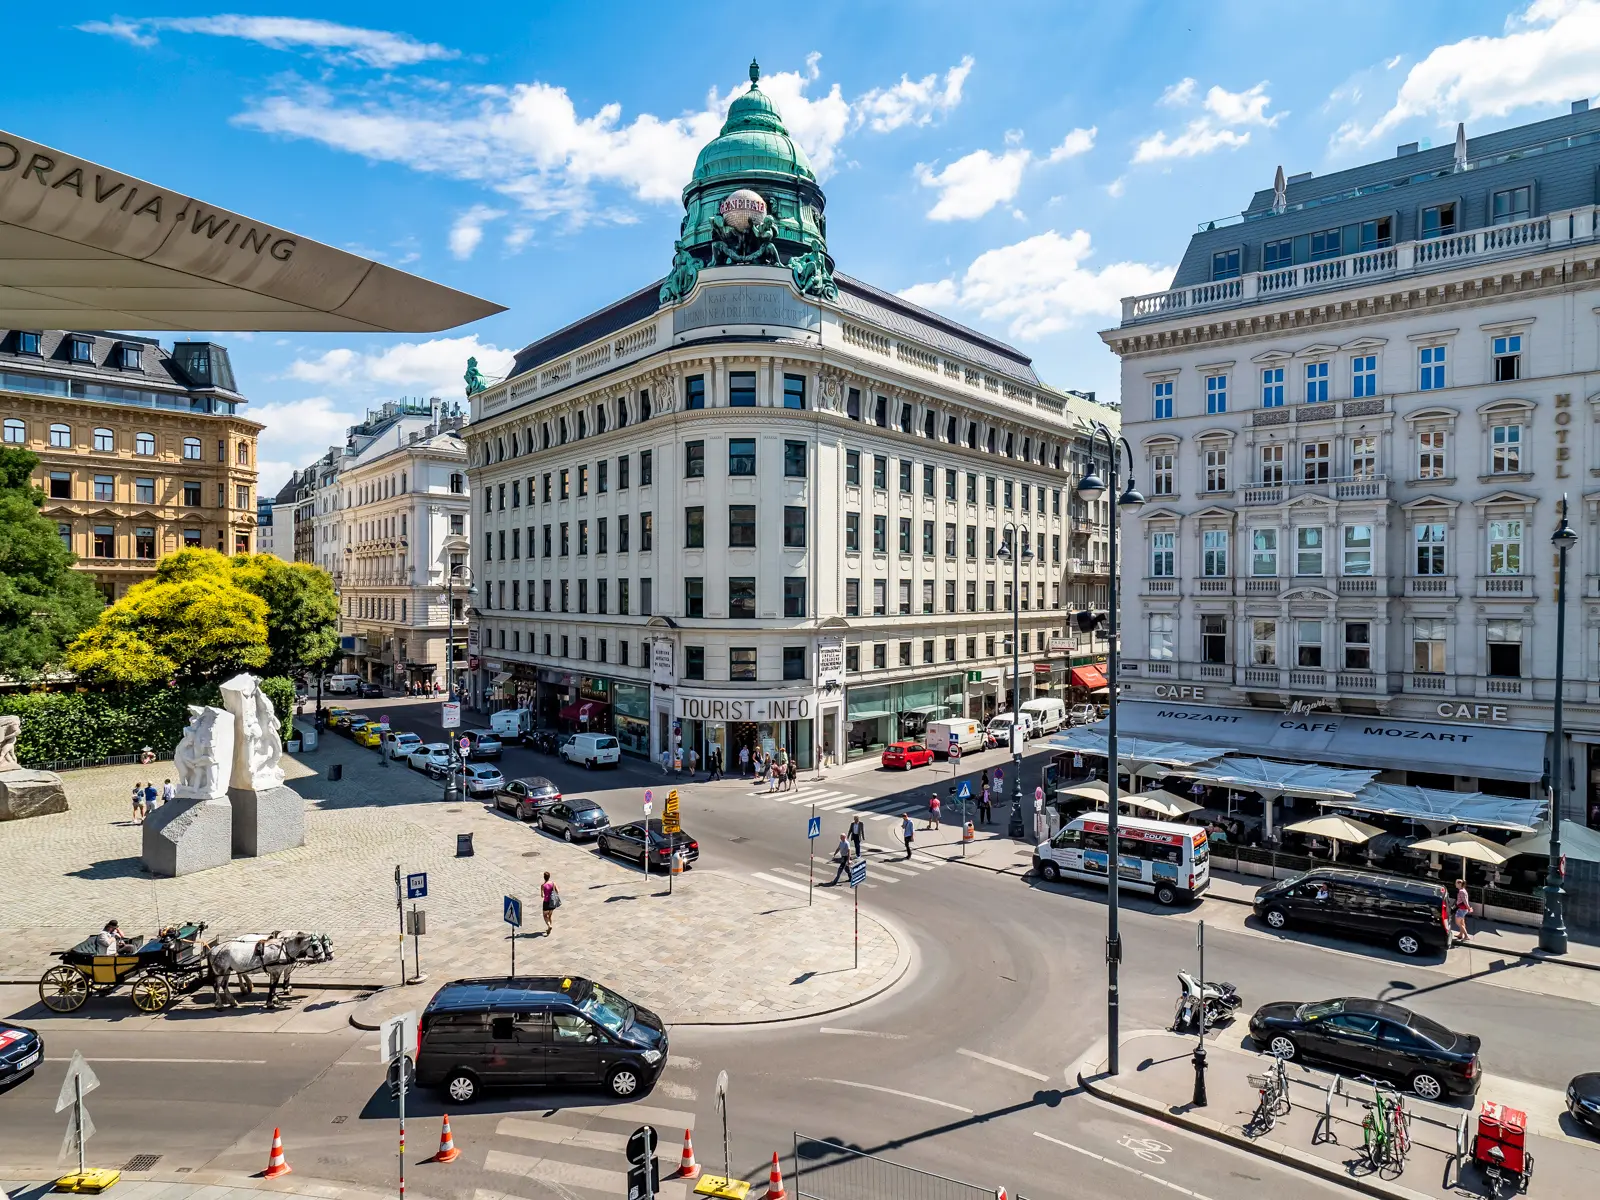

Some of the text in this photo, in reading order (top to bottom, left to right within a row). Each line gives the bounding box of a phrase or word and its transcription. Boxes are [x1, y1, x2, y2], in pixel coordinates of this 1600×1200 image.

[191, 209, 297, 262] WING
[1554, 393, 1571, 479] HOTEL
[1154, 684, 1205, 700] CAFE
[1283, 697, 1326, 717] Mozart
[1436, 702, 1508, 722] CAFE
[1156, 709, 1474, 743] MOZART CAFÉ MOZART
